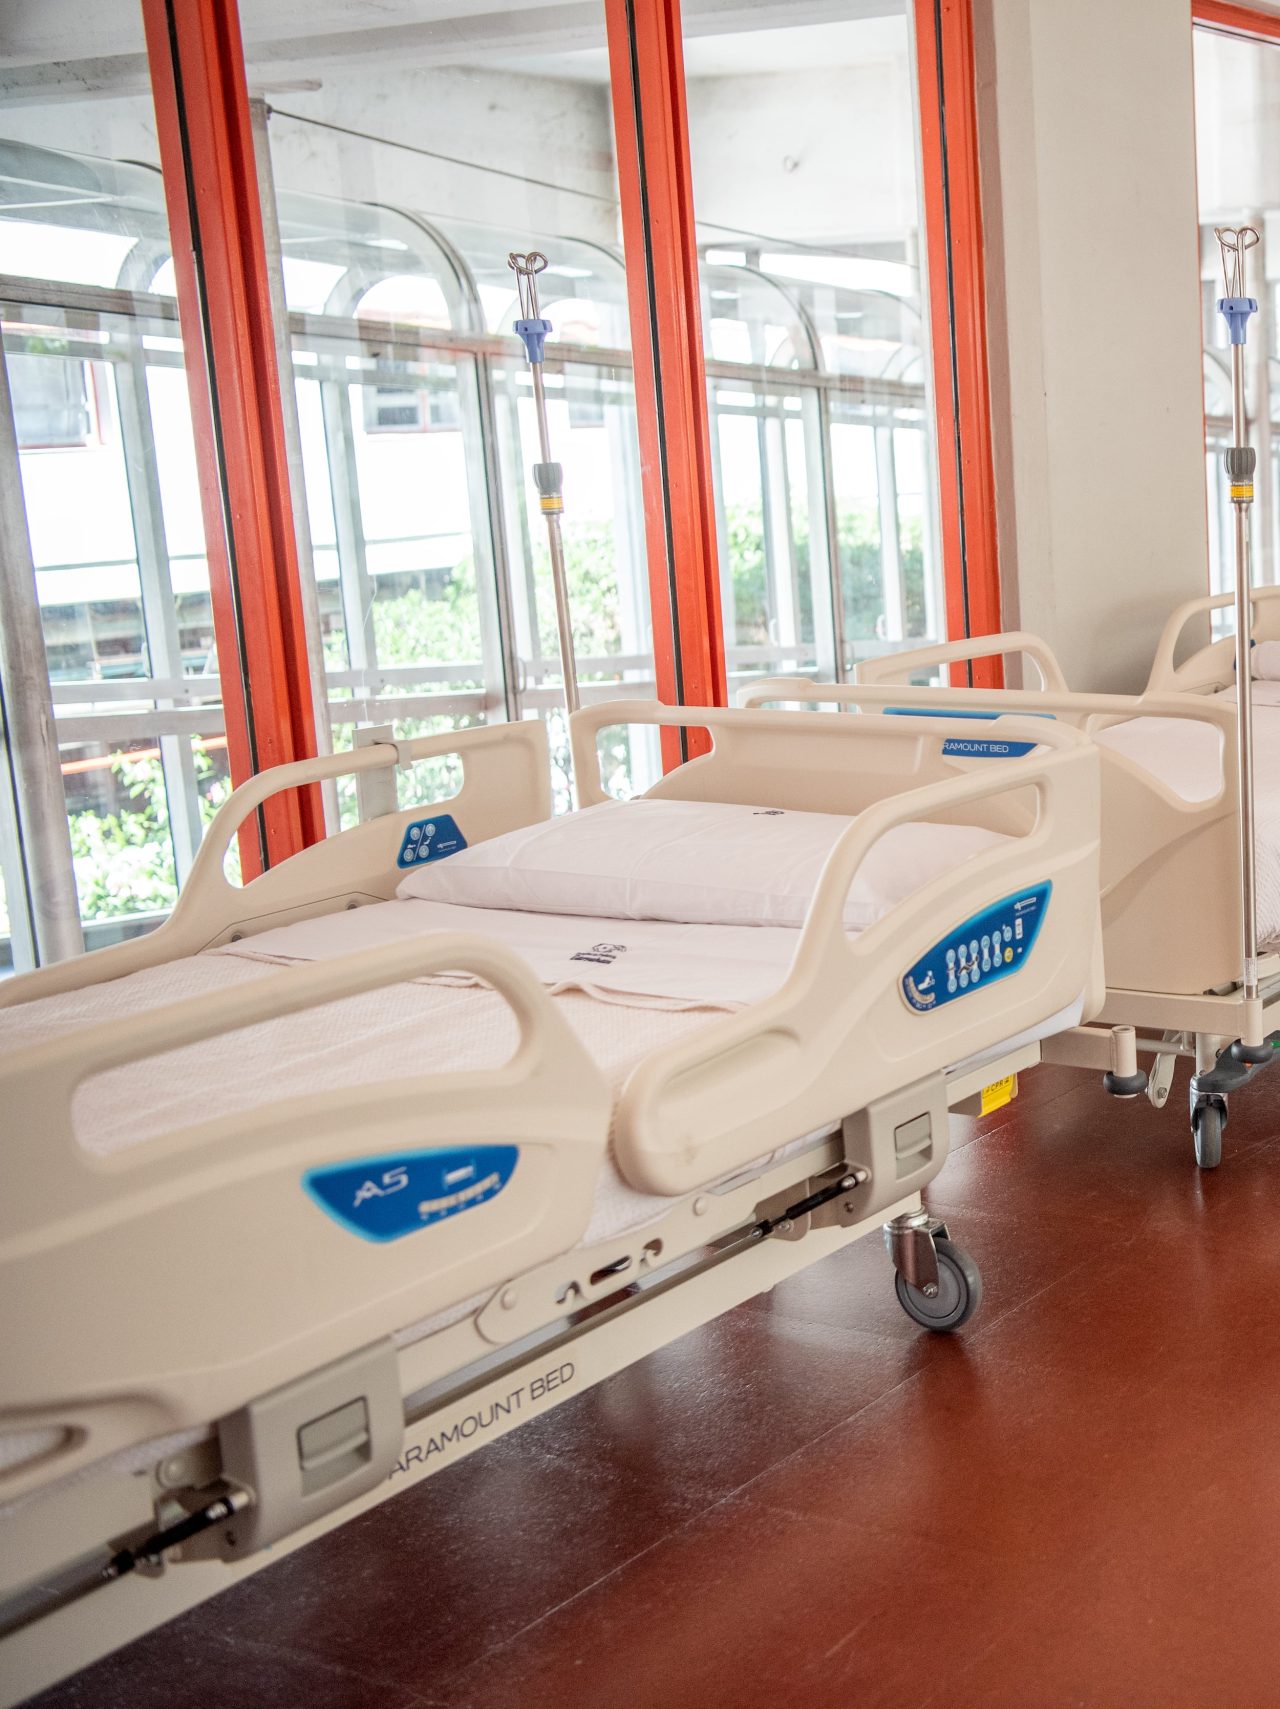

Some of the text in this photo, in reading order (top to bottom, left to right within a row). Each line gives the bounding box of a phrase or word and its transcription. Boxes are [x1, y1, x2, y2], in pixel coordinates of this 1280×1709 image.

[990, 744, 1009, 753] BED
[353, 1166, 409, 1208] A5
[529, 1362, 575, 1401] BED
